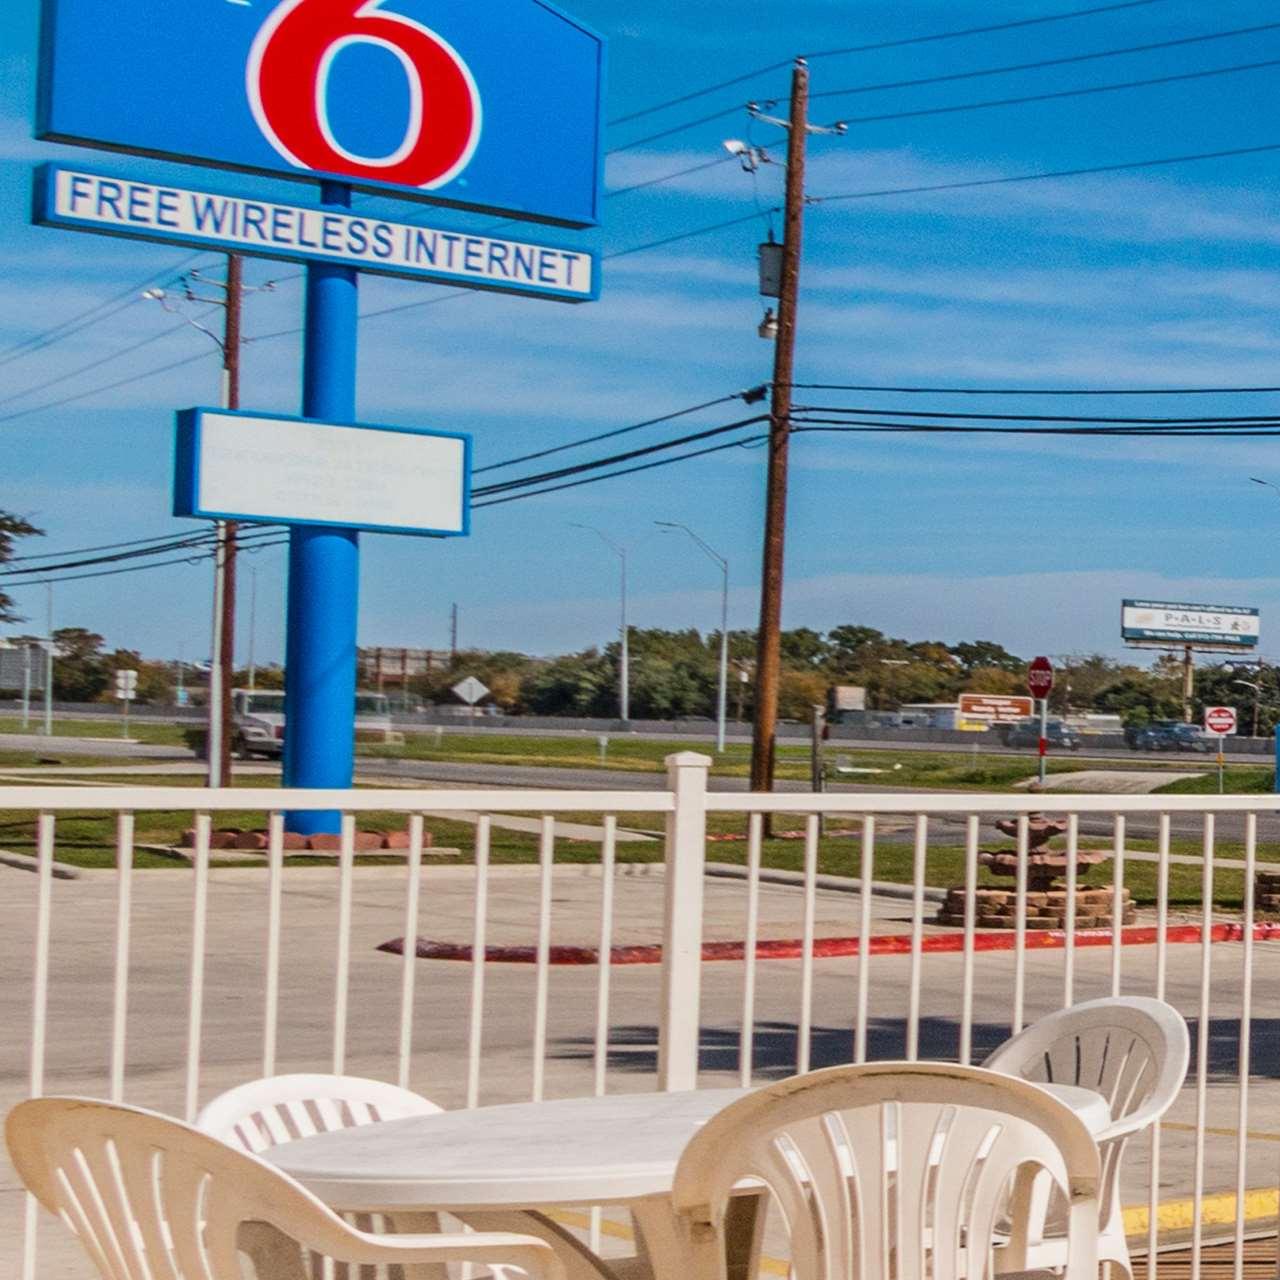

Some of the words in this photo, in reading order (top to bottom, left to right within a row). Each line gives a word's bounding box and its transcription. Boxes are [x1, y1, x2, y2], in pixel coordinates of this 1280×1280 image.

[245, 0, 482, 190] 6
[69, 174, 180, 228] FREE
[191, 193, 394, 259] WIRELESS
[404, 228, 580, 286] INTERNET
[1029, 669, 1051, 687] STOP
